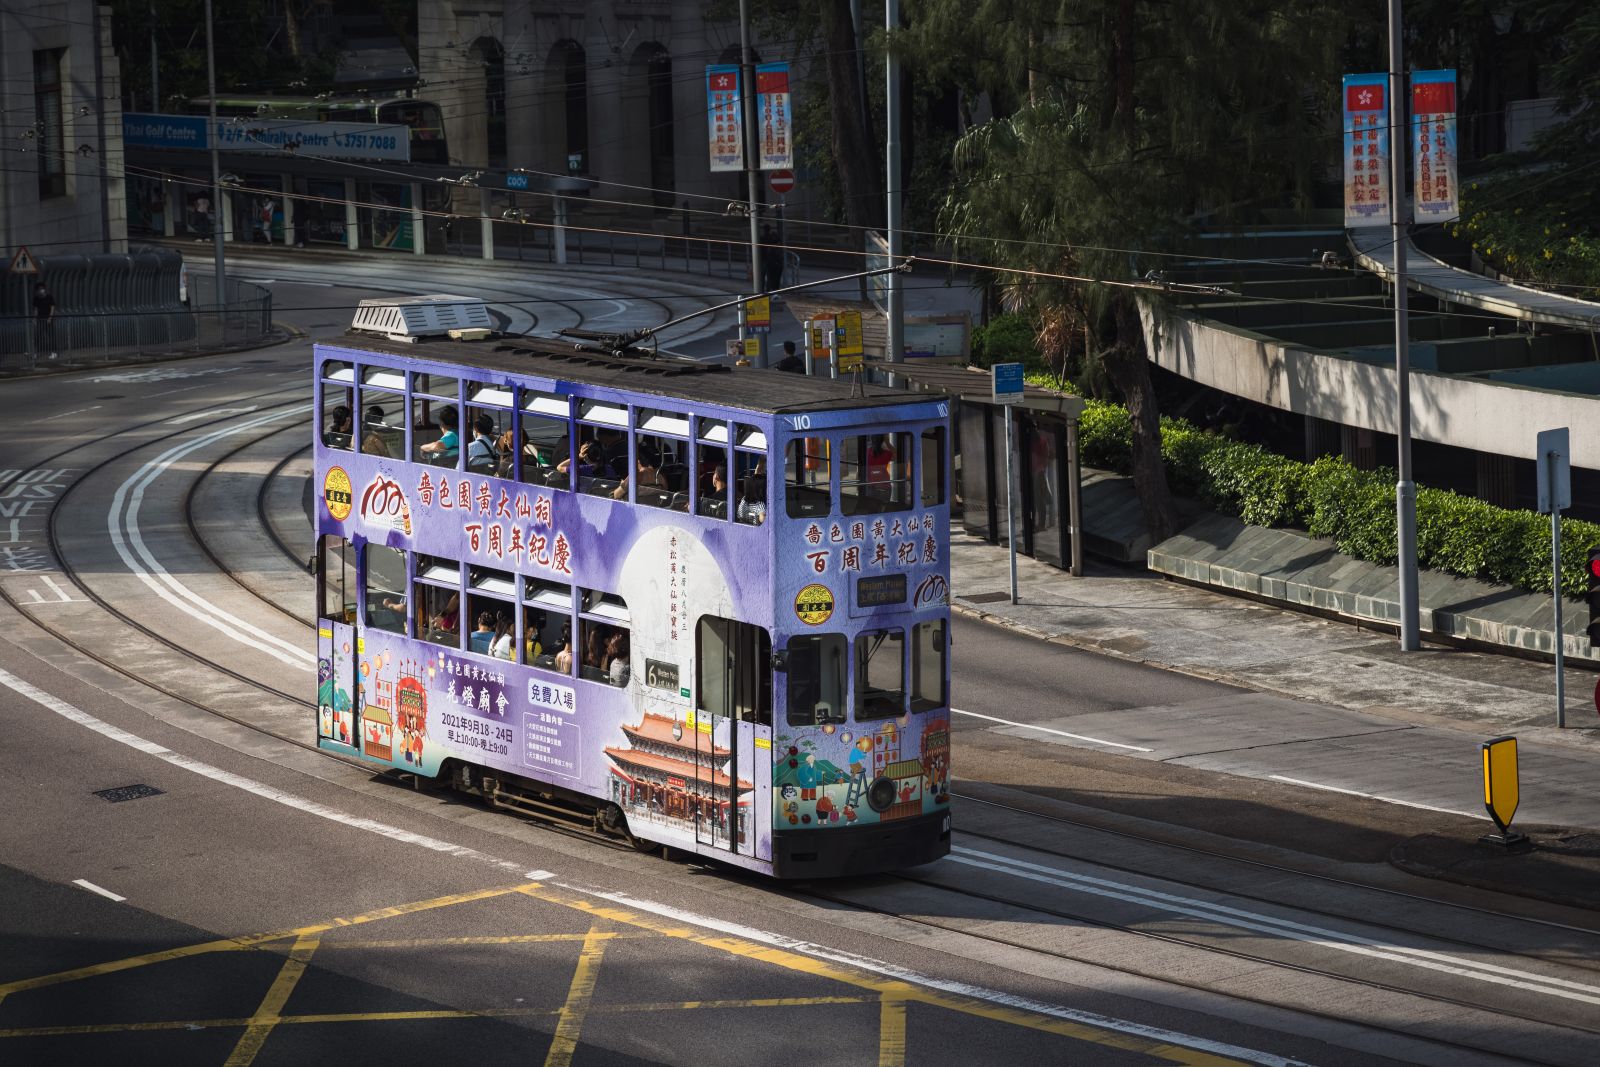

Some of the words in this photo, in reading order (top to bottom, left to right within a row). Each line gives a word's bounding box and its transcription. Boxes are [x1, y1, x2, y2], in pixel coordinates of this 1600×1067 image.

[145, 124, 164, 138] Golf
[166, 125, 197, 141] Centre
[295, 131, 329, 147] Centre
[344, 134, 367, 148] 3751
[369, 135, 397, 150] 7088
[793, 415, 811, 431] 110
[417, 472, 552, 529] 嗇色園黃大仙祠
[805, 515, 935, 544] 嗇色園黃大仙祠
[465, 523, 572, 575] 百周年紀慶
[807, 536, 938, 573] 百周年紀慶
[648, 665, 657, 688] 6
[531, 683, 574, 710] 免費入場
